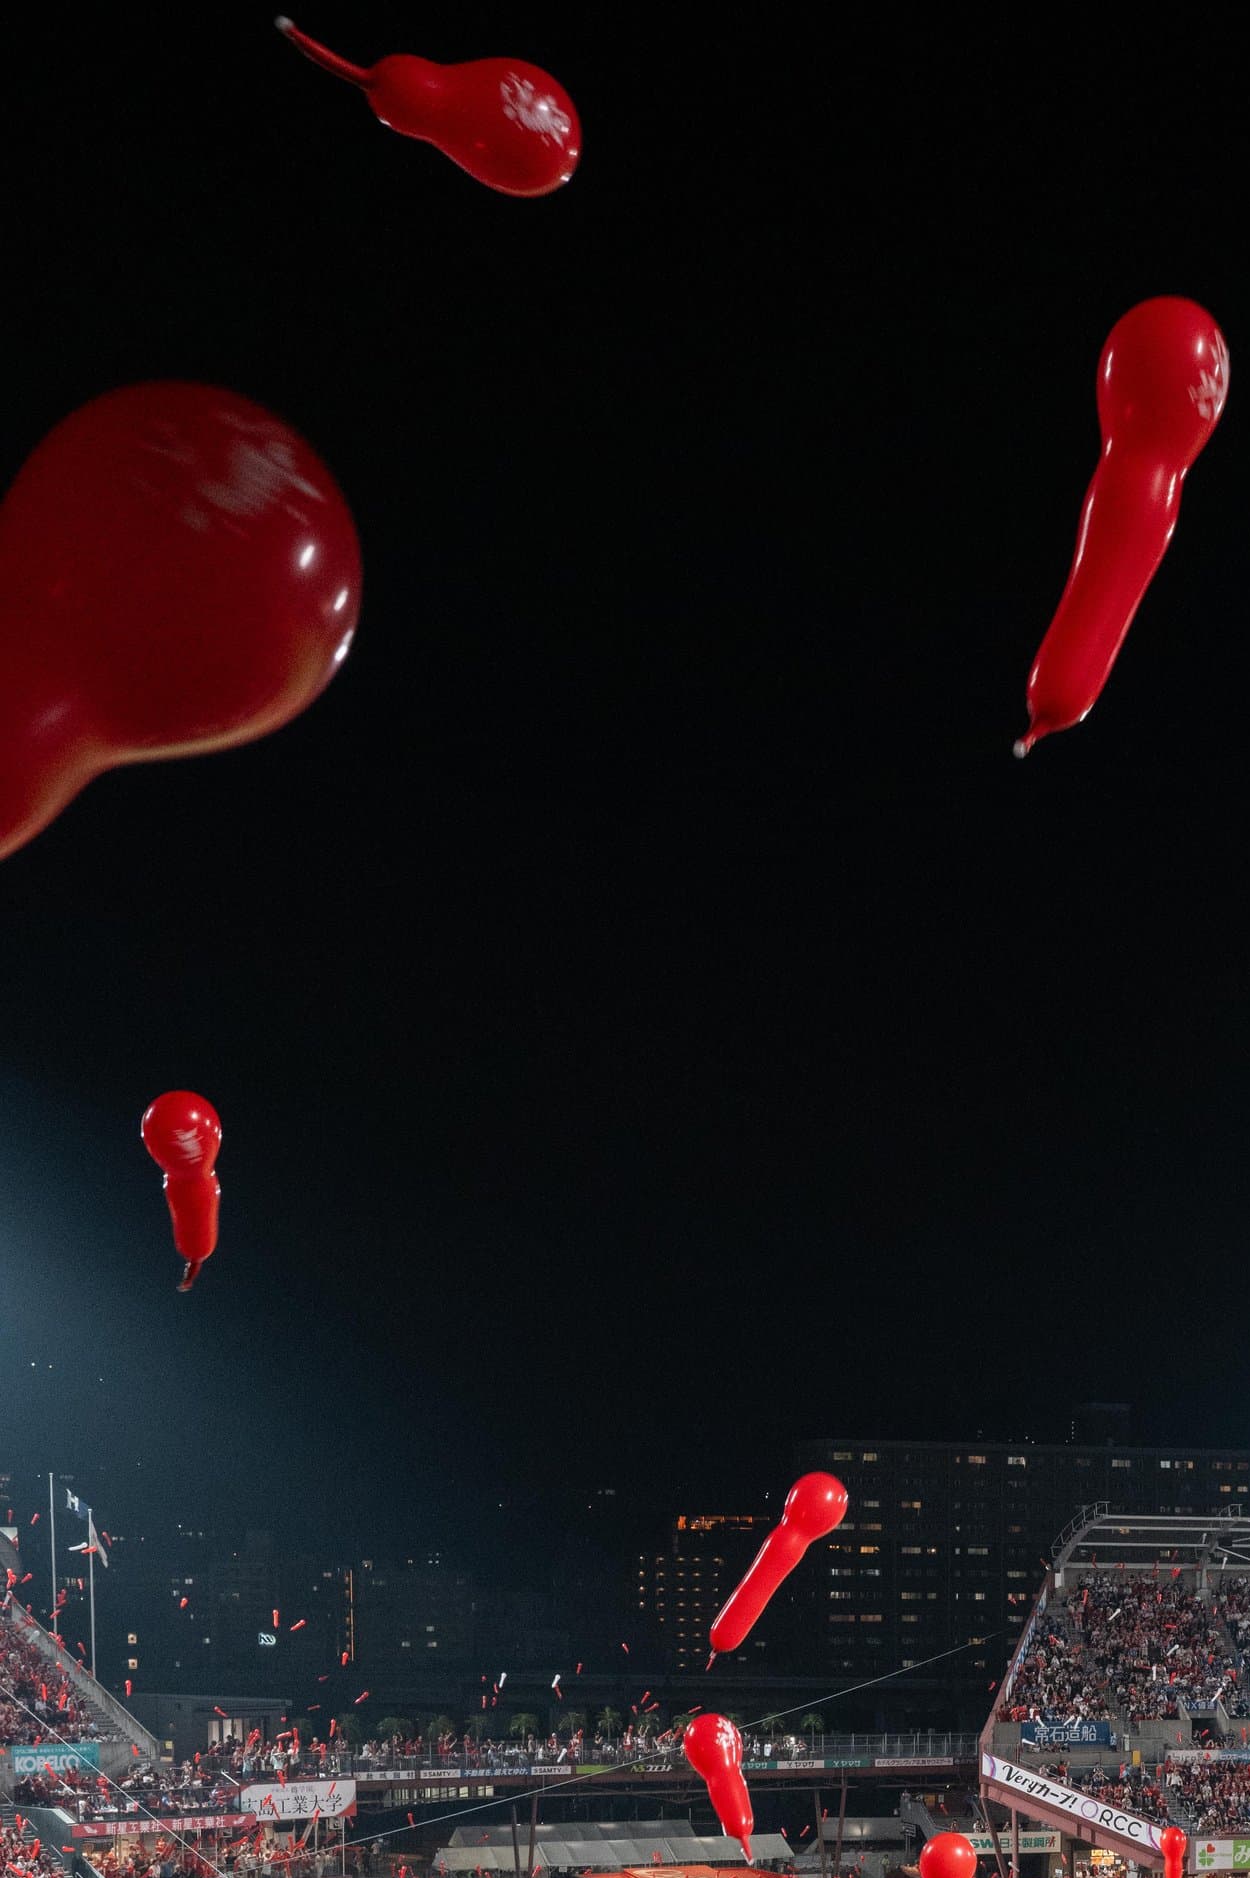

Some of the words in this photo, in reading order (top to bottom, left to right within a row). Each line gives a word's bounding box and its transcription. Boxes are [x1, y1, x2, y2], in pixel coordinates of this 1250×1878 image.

[1034, 1725, 1097, 1742] 常石造船
[1099, 1809, 1143, 1838] RCC
[1000, 1836, 1056, 1848] 日製鋼所
